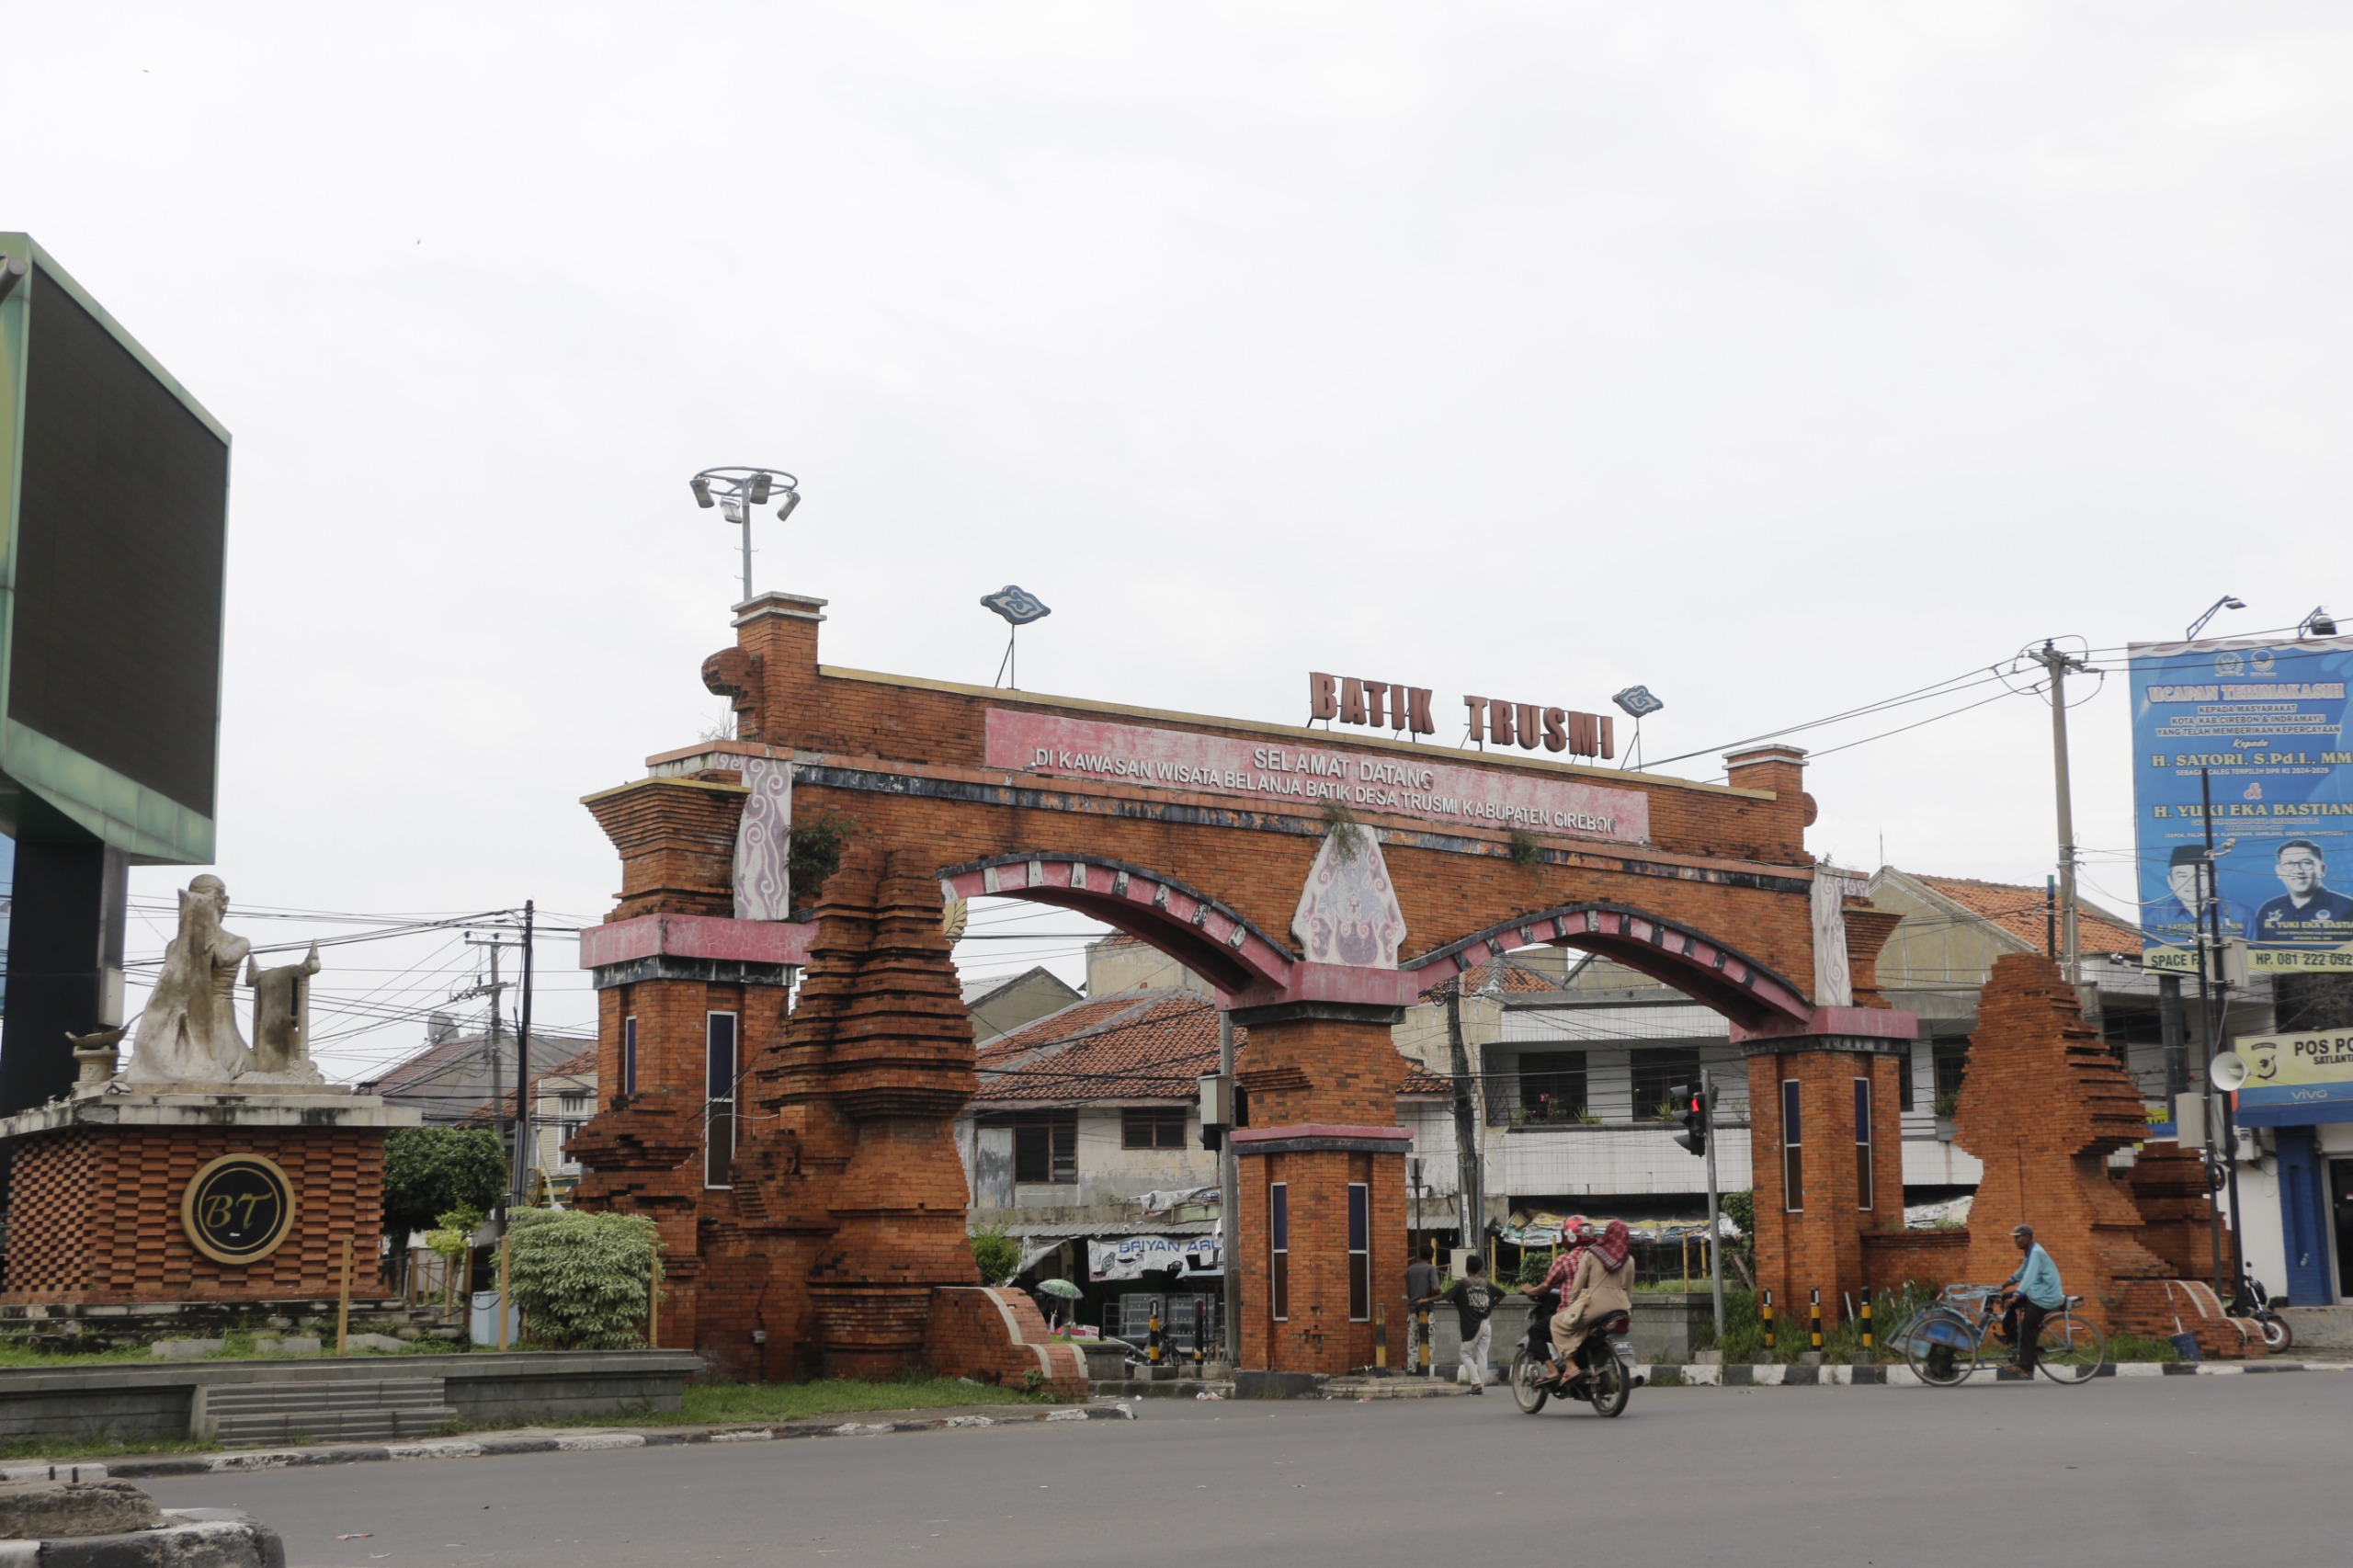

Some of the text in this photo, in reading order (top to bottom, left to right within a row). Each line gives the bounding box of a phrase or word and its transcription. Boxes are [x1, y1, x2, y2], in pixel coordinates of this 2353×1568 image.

[2148, 683, 2345, 701] UCAPAN TERIMAKASIH
[2237, 704, 2296, 712] MASYARAKAT
[1309, 672, 1614, 759] BATIK TRUSMI
[2271, 714, 2325, 722] INDRAMAYU
[2157, 725, 2341, 736] YANG TELAH MEMBERIKAN KEPERCAYAAN
[2233, 738, 2268, 749] Kepada
[2152, 755, 2170, 767] H.
[2321, 752, 2352, 764] MM
[1254, 747, 1434, 790] SELAMAT DATANG
[1036, 748, 1617, 834] DI KAWASAN WISATA BELANJA BATIK DESA TRUSMI KABUPATEN CIREBON
[2244, 782, 2262, 800] &
[2154, 805, 2172, 818] H.
[2230, 804, 2268, 816] EKA
[2151, 954, 2187, 966] SPACE
[2256, 953, 2272, 965] HP.
[2277, 953, 2298, 965] 081
[2303, 953, 2325, 965] 222
[2294, 1039, 2329, 1056] POS
[2291, 1088, 2328, 1100] vivo
[206, 1191, 273, 1230] BT
[1119, 1241, 1180, 1253] BRIYAN
